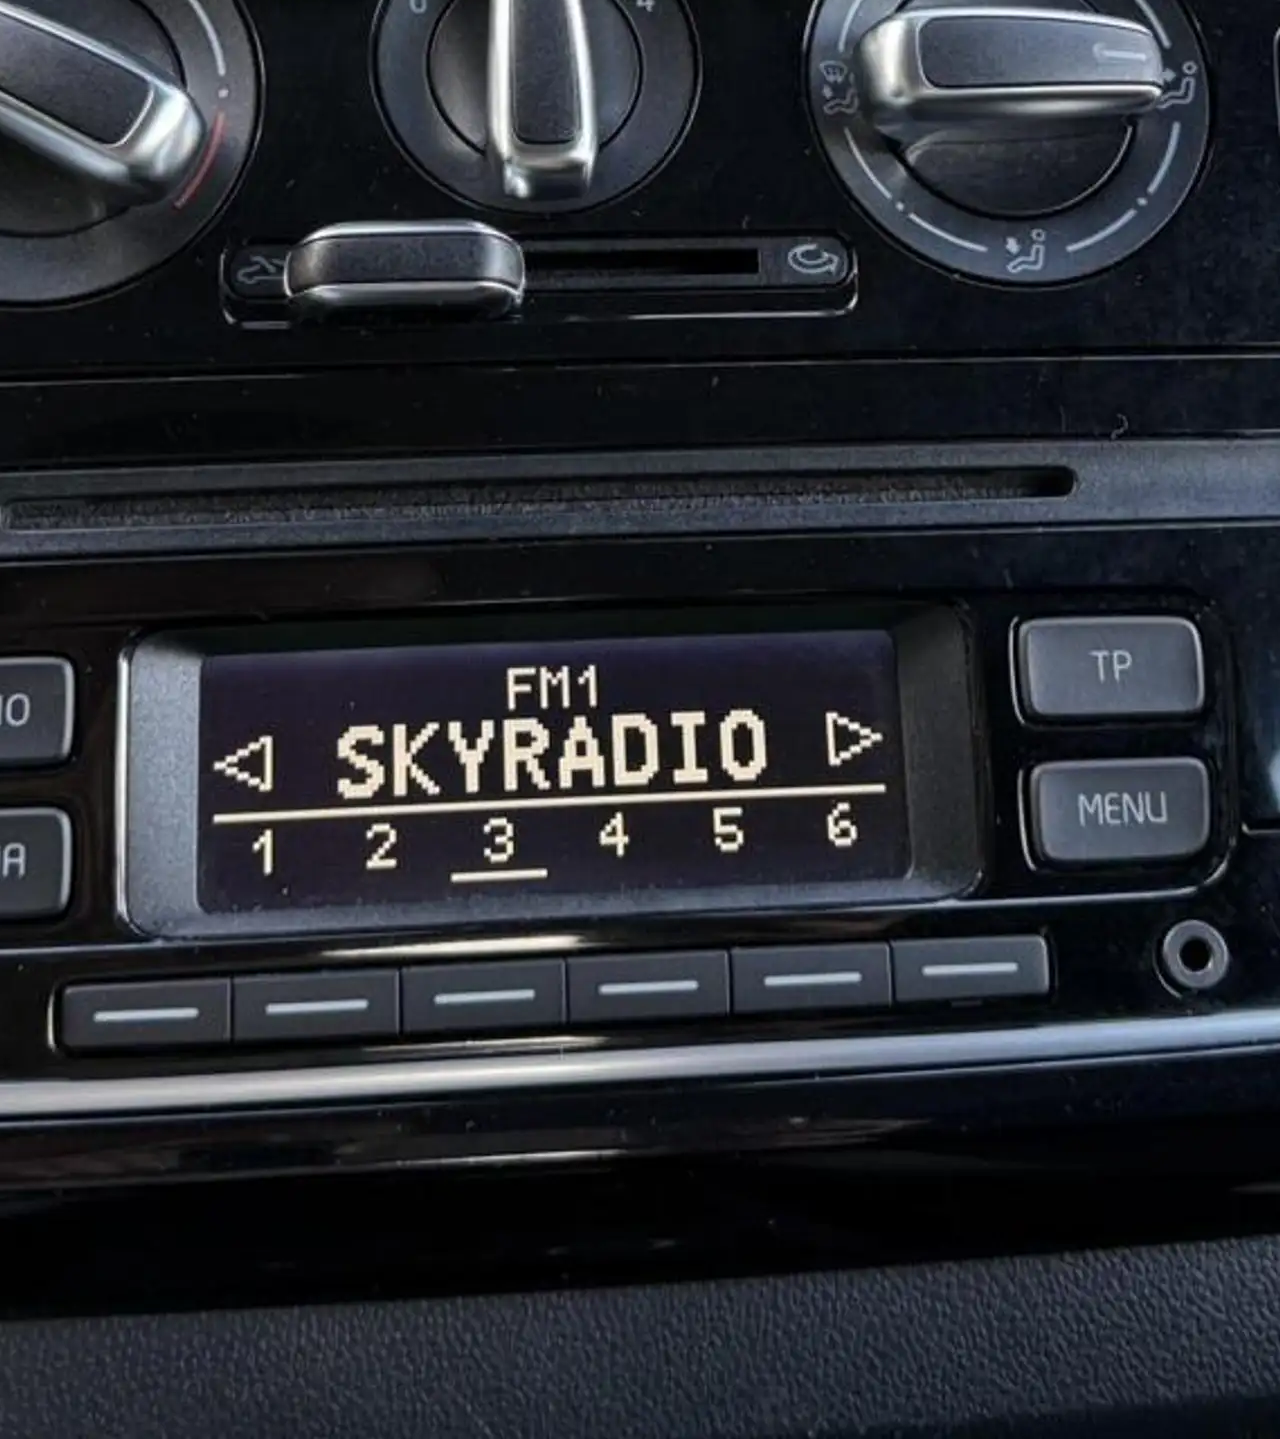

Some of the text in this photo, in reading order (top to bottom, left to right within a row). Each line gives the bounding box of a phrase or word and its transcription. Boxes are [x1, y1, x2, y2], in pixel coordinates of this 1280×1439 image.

[507, 665, 598, 710] FM1
[1090, 650, 1133, 681] TP
[336, 708, 766, 800] SKYRADIO
[1077, 789, 1168, 828] MENU
[252, 802, 858, 876] 1 2 3 4 5 6
